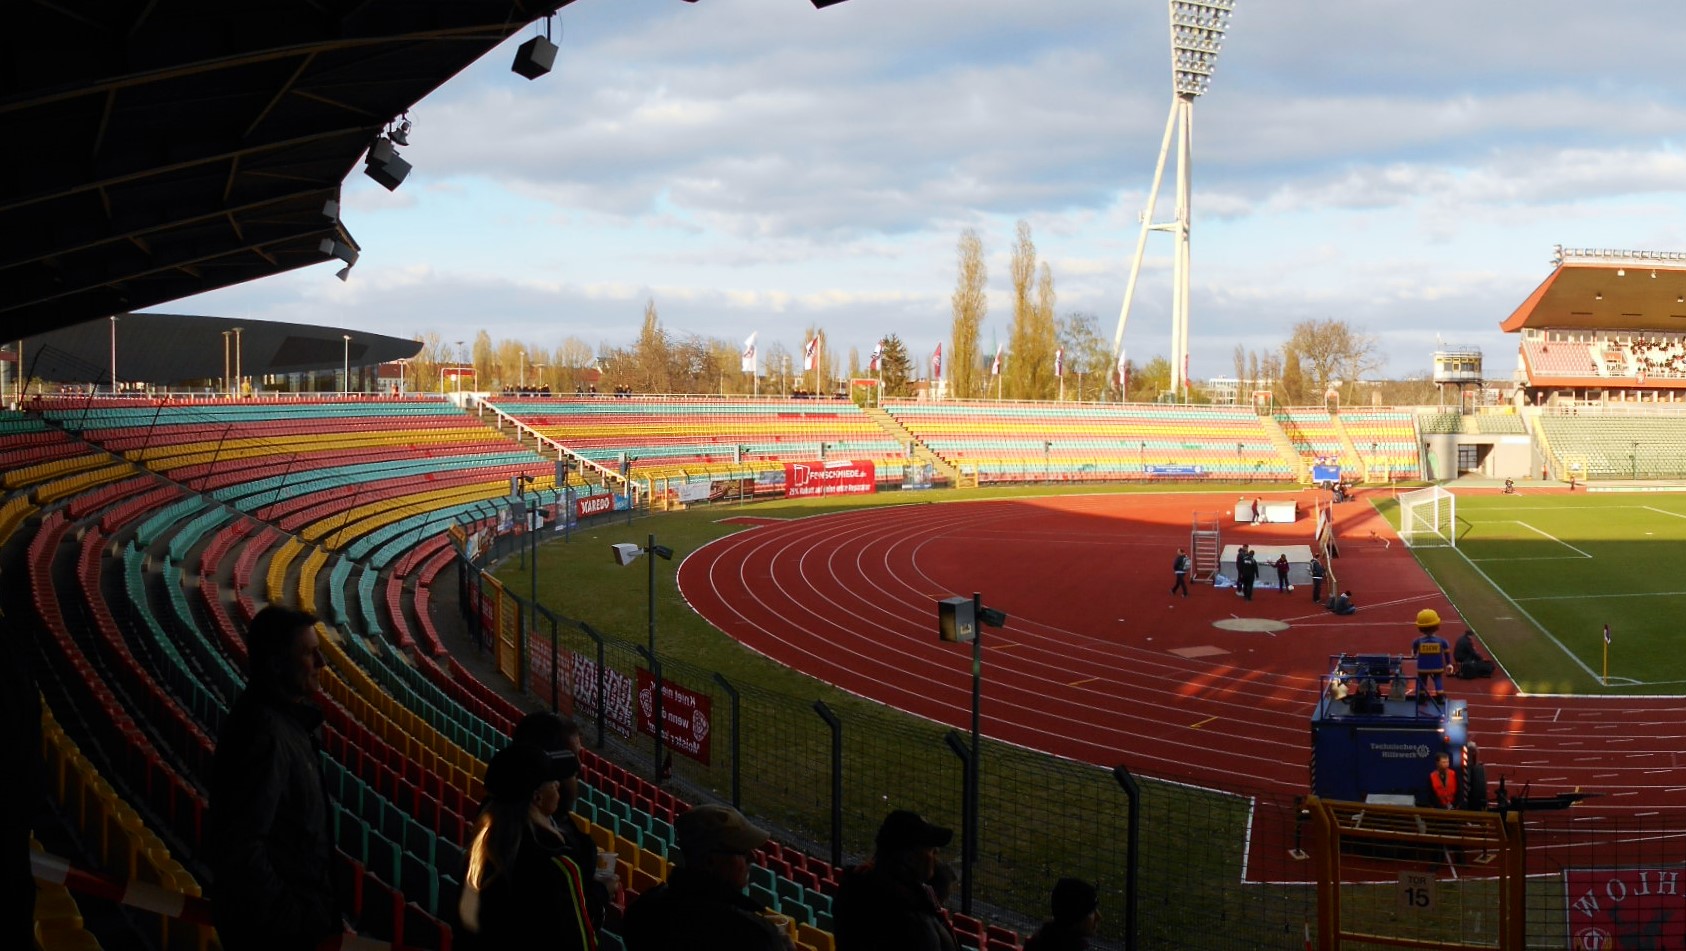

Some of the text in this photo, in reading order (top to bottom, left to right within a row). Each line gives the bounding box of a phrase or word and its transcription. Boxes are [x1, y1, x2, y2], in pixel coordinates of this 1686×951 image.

[580, 497, 610, 515] MAREDO
[1369, 742, 1417, 750] Technisches
[1382, 751, 1417, 759] Hilfswerk
[1408, 875, 1426, 885] TOR
[1405, 886, 1429, 907] 15
